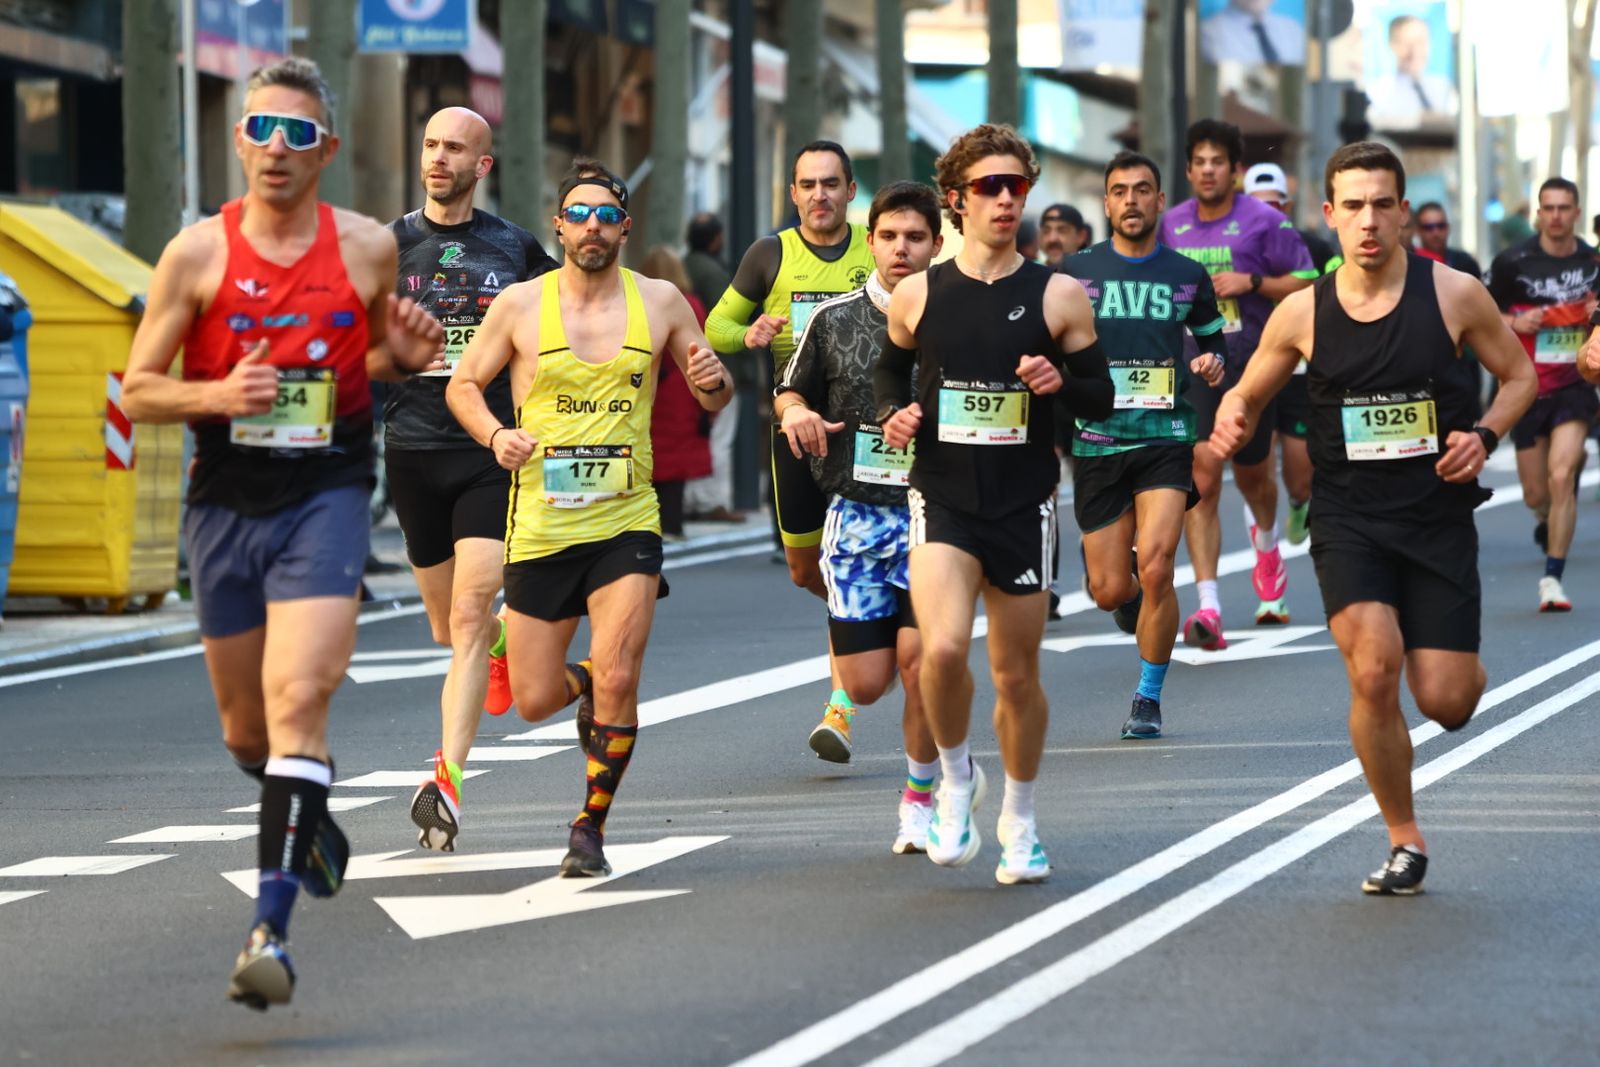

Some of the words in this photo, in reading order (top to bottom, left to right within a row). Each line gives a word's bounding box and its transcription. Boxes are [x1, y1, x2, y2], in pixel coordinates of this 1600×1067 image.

[1099, 280, 1172, 320] AVS
[1128, 370, 1150, 384] 42
[556, 395, 597, 414] RUN
[608, 399, 632, 413] GO
[963, 395, 1006, 413] 597
[1361, 406, 1418, 427] 1926
[569, 461, 610, 478] 177
